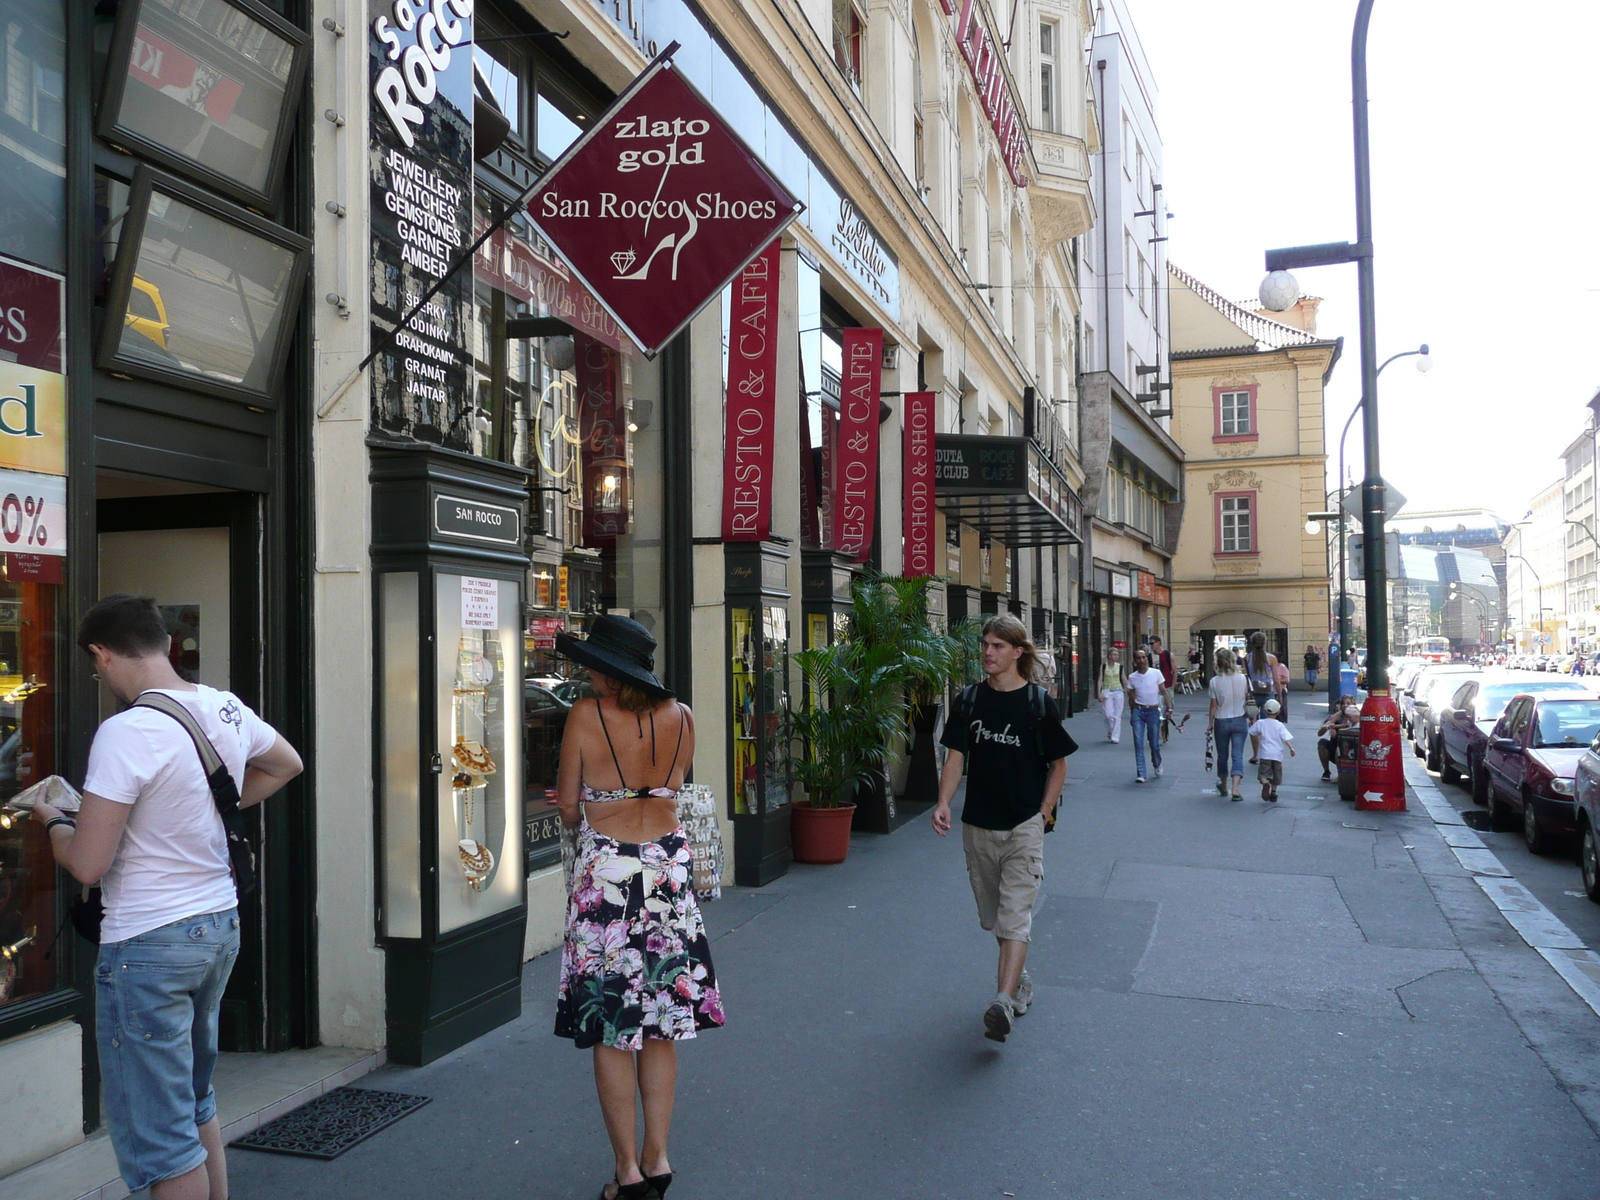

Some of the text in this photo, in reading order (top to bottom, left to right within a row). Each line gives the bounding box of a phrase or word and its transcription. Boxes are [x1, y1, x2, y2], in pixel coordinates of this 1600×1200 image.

[614, 115, 710, 139] zlato
[617, 142, 705, 172] gold
[386, 149, 461, 206] JEWELLERY
[392, 171, 455, 224] WATCHES
[542, 192, 776, 219] San Rocco Shoes
[385, 192, 461, 247] GEMSTONES
[397, 220, 452, 262] GARNET
[401, 243, 448, 279] AMBER
[396, 332, 454, 365] DRAHOKAMY
[405, 357, 447, 383] GRANÁT
[406, 380, 445, 403] JANTAR
[732, 256, 769, 536] RESTO & CAFE
[840, 341, 873, 555] RESTO & CAFE
[935, 449, 963, 463] DUTA
[912, 400, 928, 571] OBCHOD & SHOP
[943, 465, 969, 479] CLUB
[456, 507, 502, 526] SAN ROCCO
[970, 719, 1021, 747] Fender
[1379, 714, 1395, 723] club
